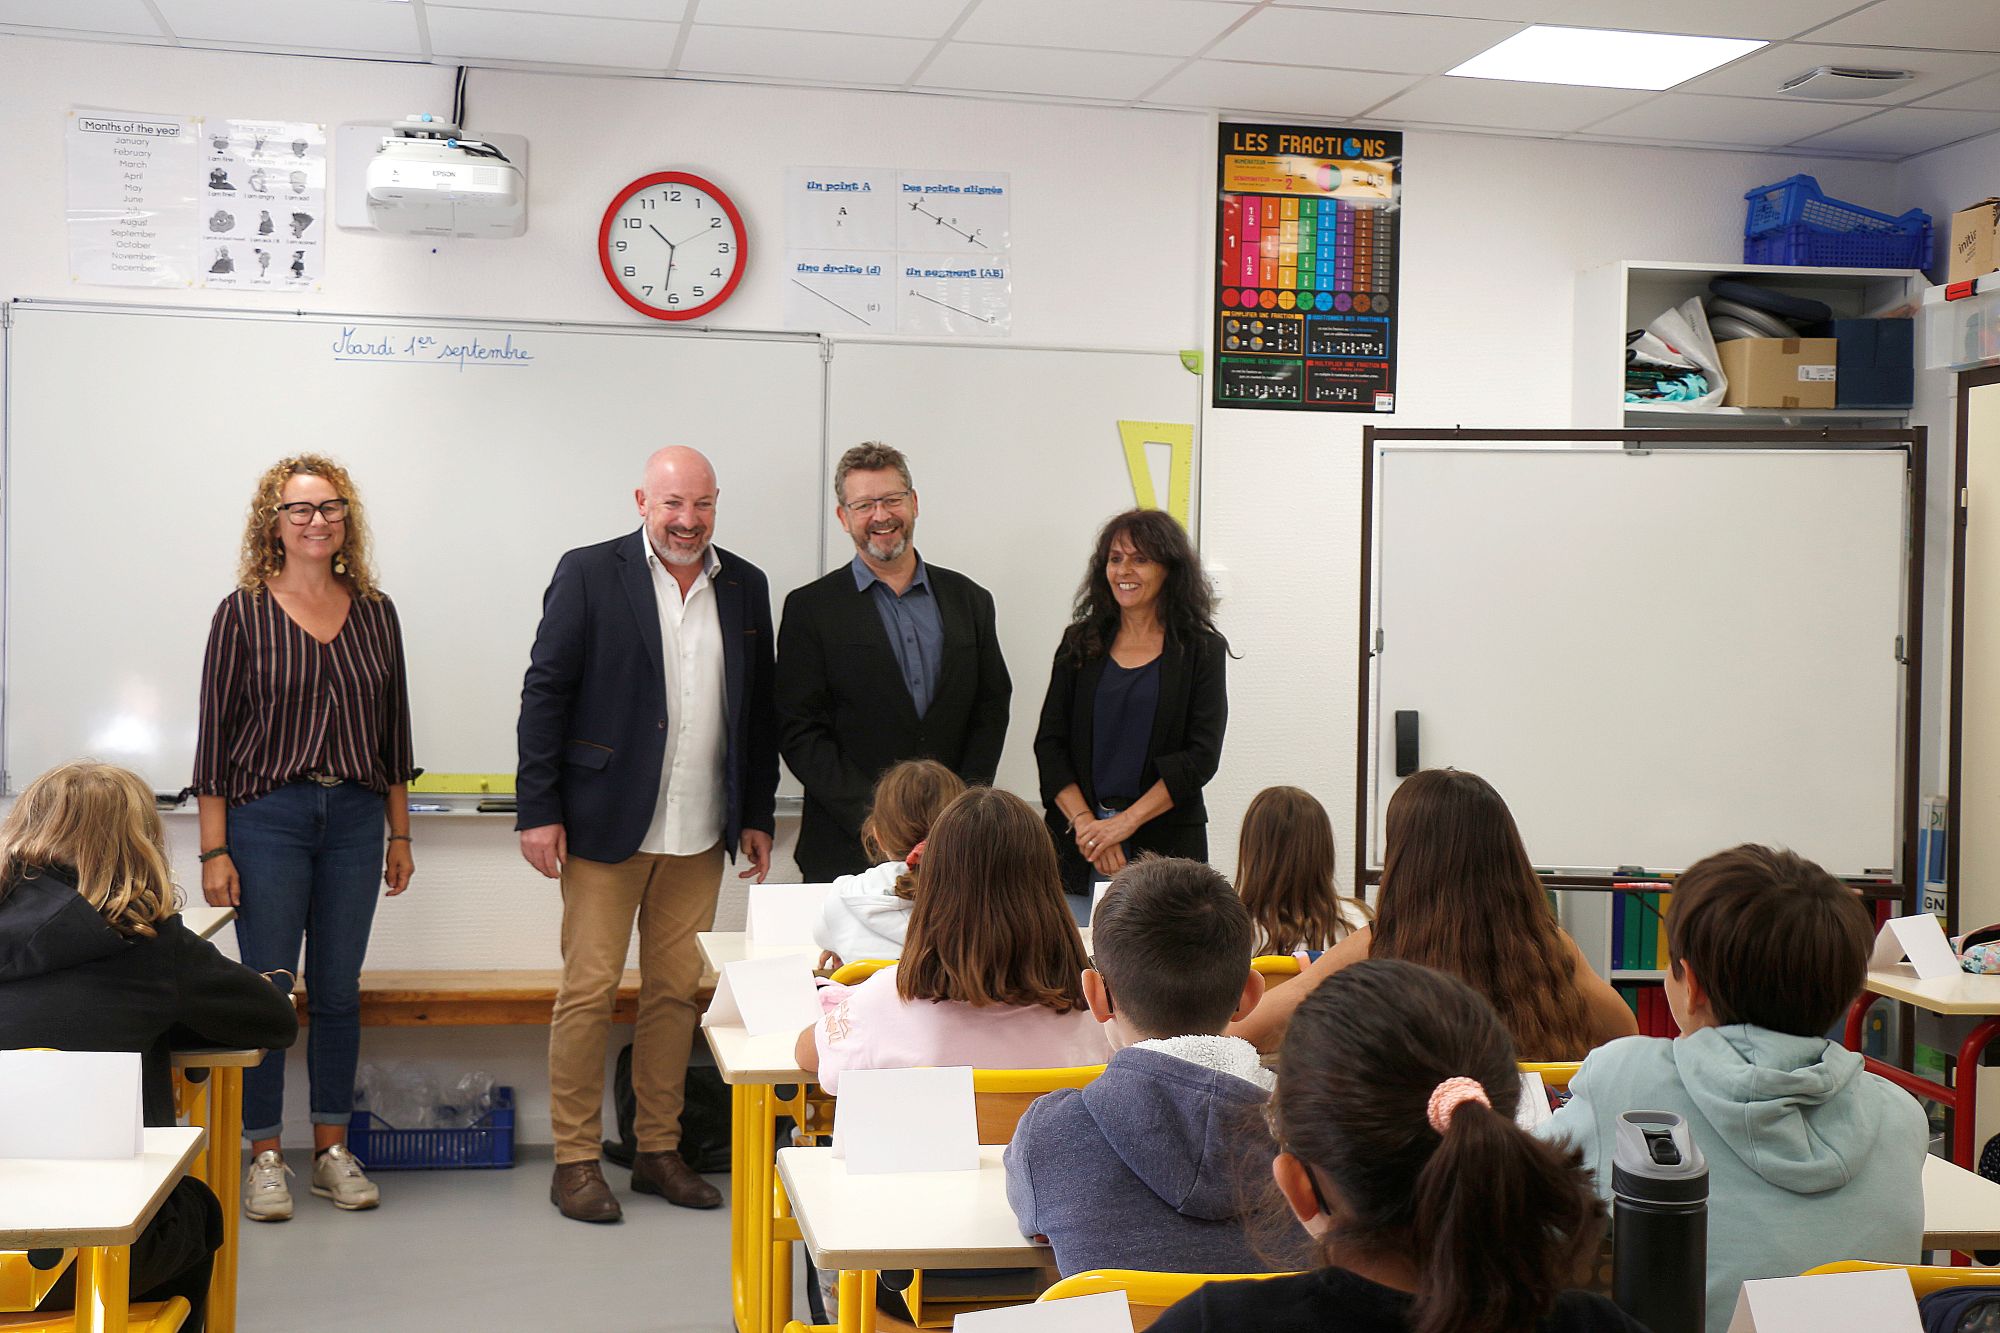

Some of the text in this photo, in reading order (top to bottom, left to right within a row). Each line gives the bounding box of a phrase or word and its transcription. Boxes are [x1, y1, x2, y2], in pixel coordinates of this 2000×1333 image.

[85, 121, 180, 136] Months of the year
[115, 137, 150, 146] January
[1233, 132, 1269, 152] LES
[114, 148, 152, 158] February
[120, 160, 147, 168] March
[124, 172, 143, 180] April
[432, 170, 456, 178] EPSON
[124, 184, 142, 192] May
[806, 182, 872, 192] Un point A
[902, 184, 922, 192] Des
[925, 184, 960, 194] points
[1285, 178, 1293, 190] 2
[662, 191, 682, 202] 12
[640, 199, 655, 210] 11
[696, 198, 701, 208] 1
[838, 206, 847, 216] A
[120, 218, 148, 228] August
[622, 218, 642, 228] 10
[710, 218, 722, 228] 2
[112, 229, 156, 238] September
[116, 241, 150, 249] October
[616, 241, 627, 252] 9
[1228, 235, 1236, 248] 1
[718, 242, 730, 254] 3
[112, 252, 156, 260] November
[112, 263, 156, 272] December
[624, 266, 636, 276] 8
[797, 263, 881, 275] Une droite (d)
[710, 268, 722, 278] 4
[906, 268, 921, 276] Un
[924, 269, 977, 278] segment
[642, 286, 654, 296] 7
[693, 286, 704, 296] 5
[668, 293, 680, 304] 6
[867, 303, 880, 312] (d)
[333, 326, 396, 356] Mardi
[437, 334, 535, 373] septembre
